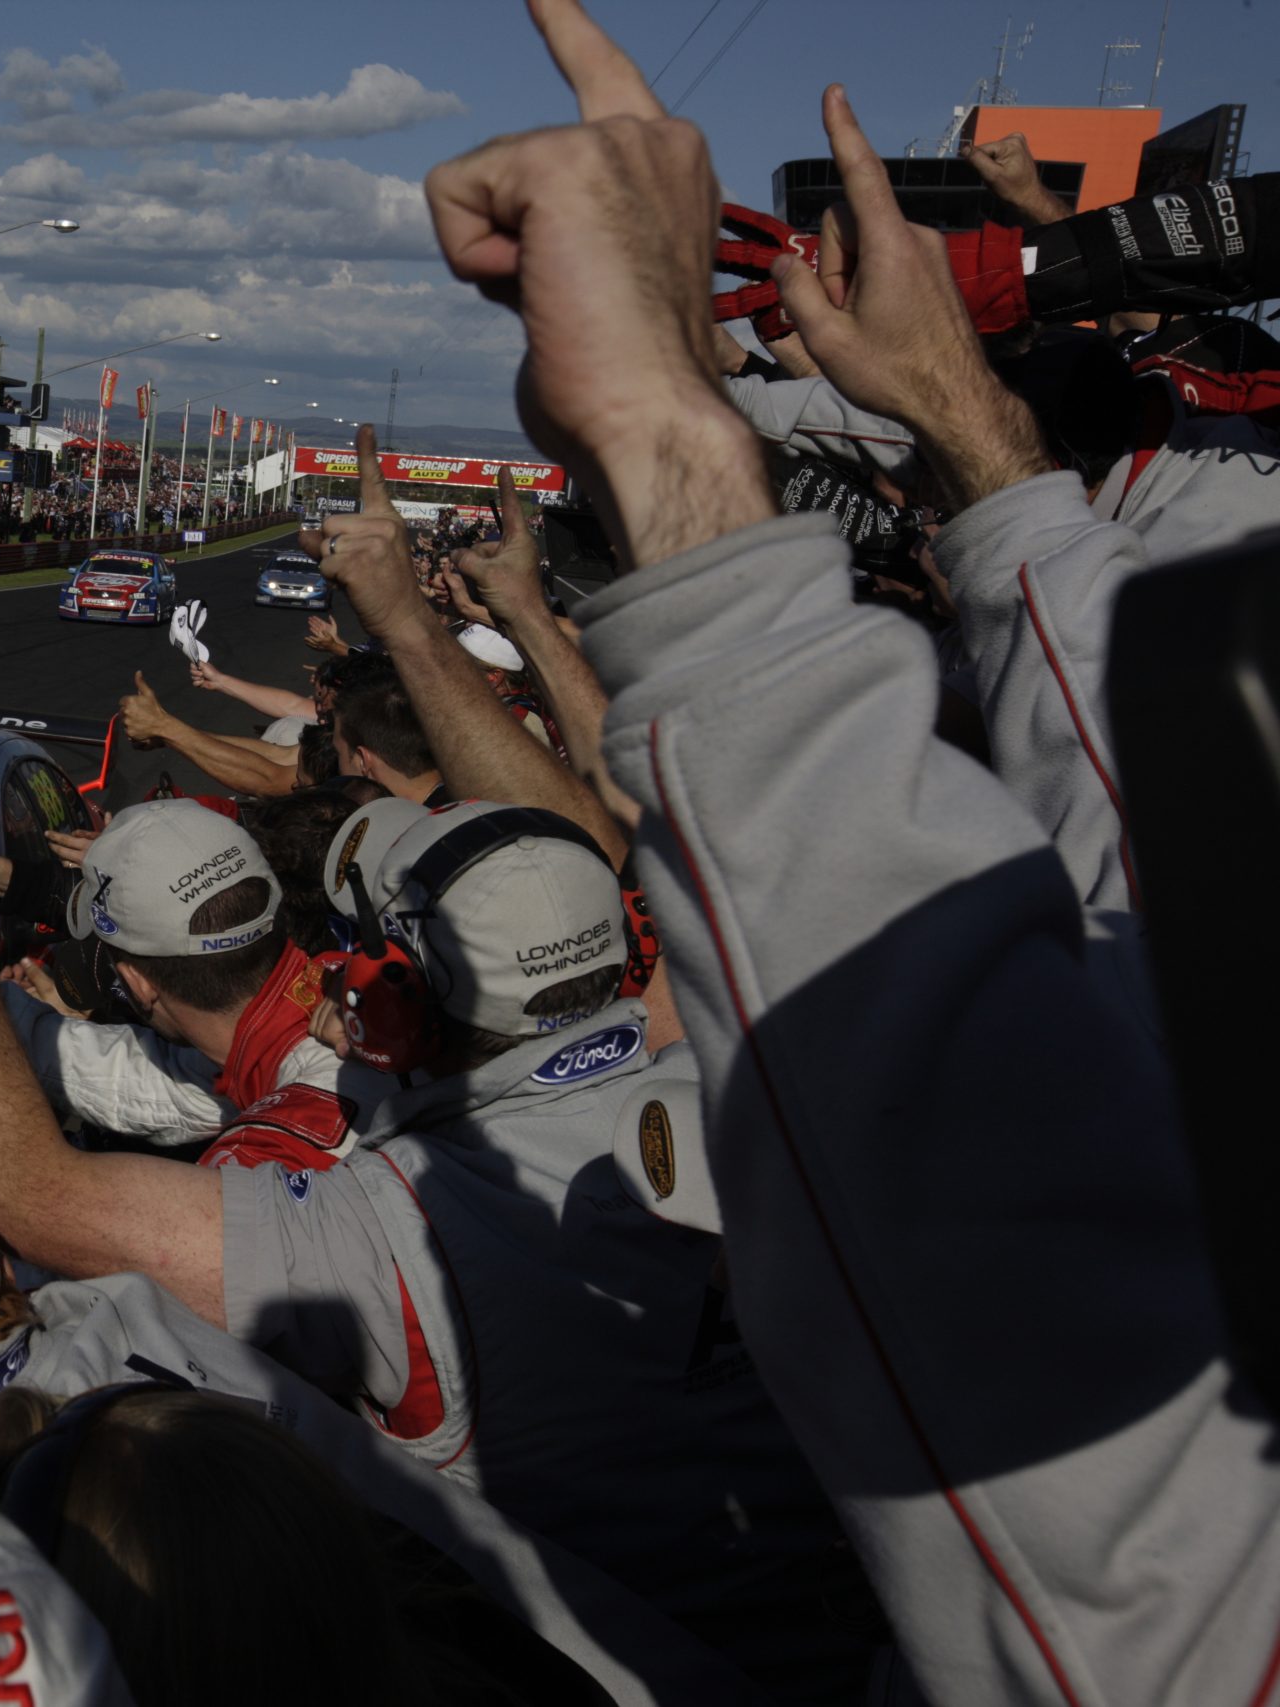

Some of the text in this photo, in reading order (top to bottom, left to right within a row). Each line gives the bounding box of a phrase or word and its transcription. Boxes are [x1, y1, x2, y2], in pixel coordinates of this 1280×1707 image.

[1157, 206, 1183, 255] SPRINGS
[1170, 196, 1204, 255] Eibach
[397, 457, 466, 473] SUPERCHEAP
[481, 463, 552, 479] SURCHEAP
[828, 484, 847, 515] autod
[94, 554, 150, 563] HOLDEN
[169, 846, 241, 894] LOWNDES
[179, 858, 247, 904] WHINCUP
[202, 928, 263, 952] NOKIA
[516, 919, 611, 963] LOWNDES
[522, 939, 611, 978] WHINCUP
[554, 1033, 623, 1077] Ford
